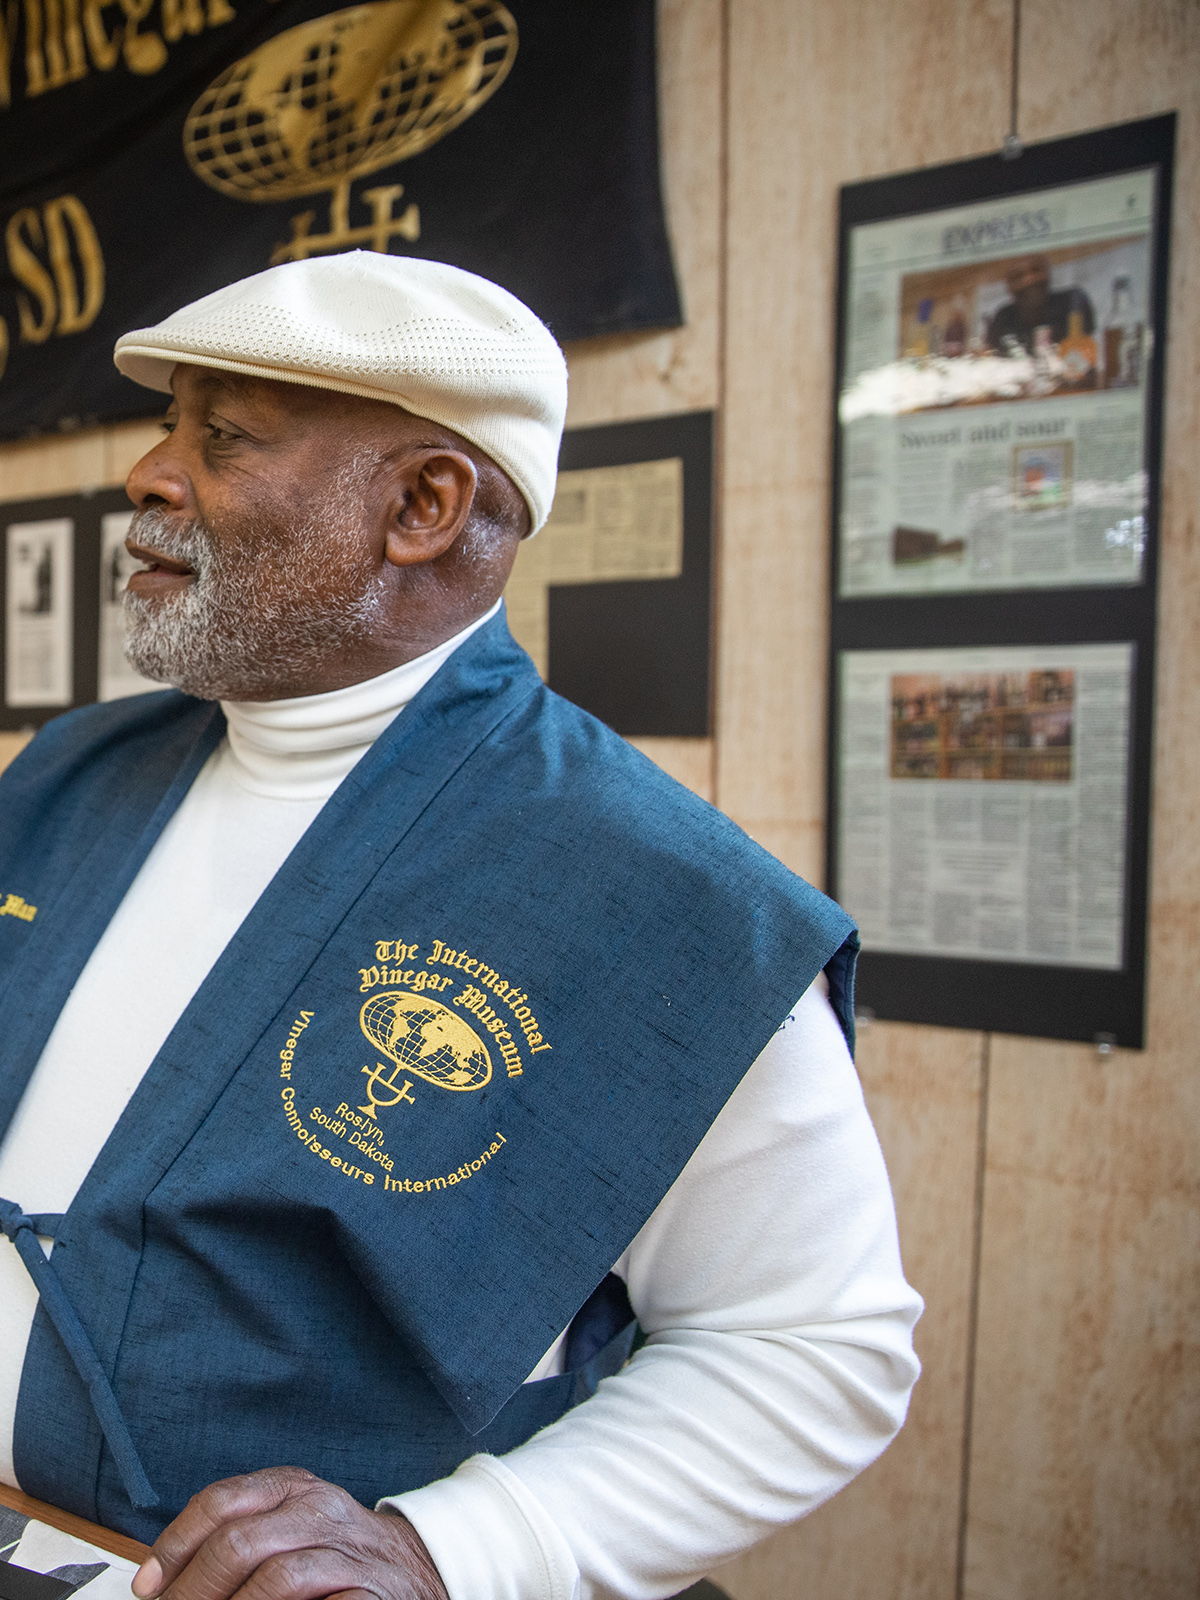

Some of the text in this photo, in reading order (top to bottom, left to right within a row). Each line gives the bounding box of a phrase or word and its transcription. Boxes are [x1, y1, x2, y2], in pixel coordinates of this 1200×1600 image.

[5, 194, 105, 345] SD
[358, 965, 523, 1078] Vinegar Museum
[375, 939, 553, 1055] The International
[280, 1010, 507, 1193] Vinegar Connoisseurs International
[309, 1107, 395, 1172] South Dakota
[335, 1102, 385, 1146] Roslyn,
